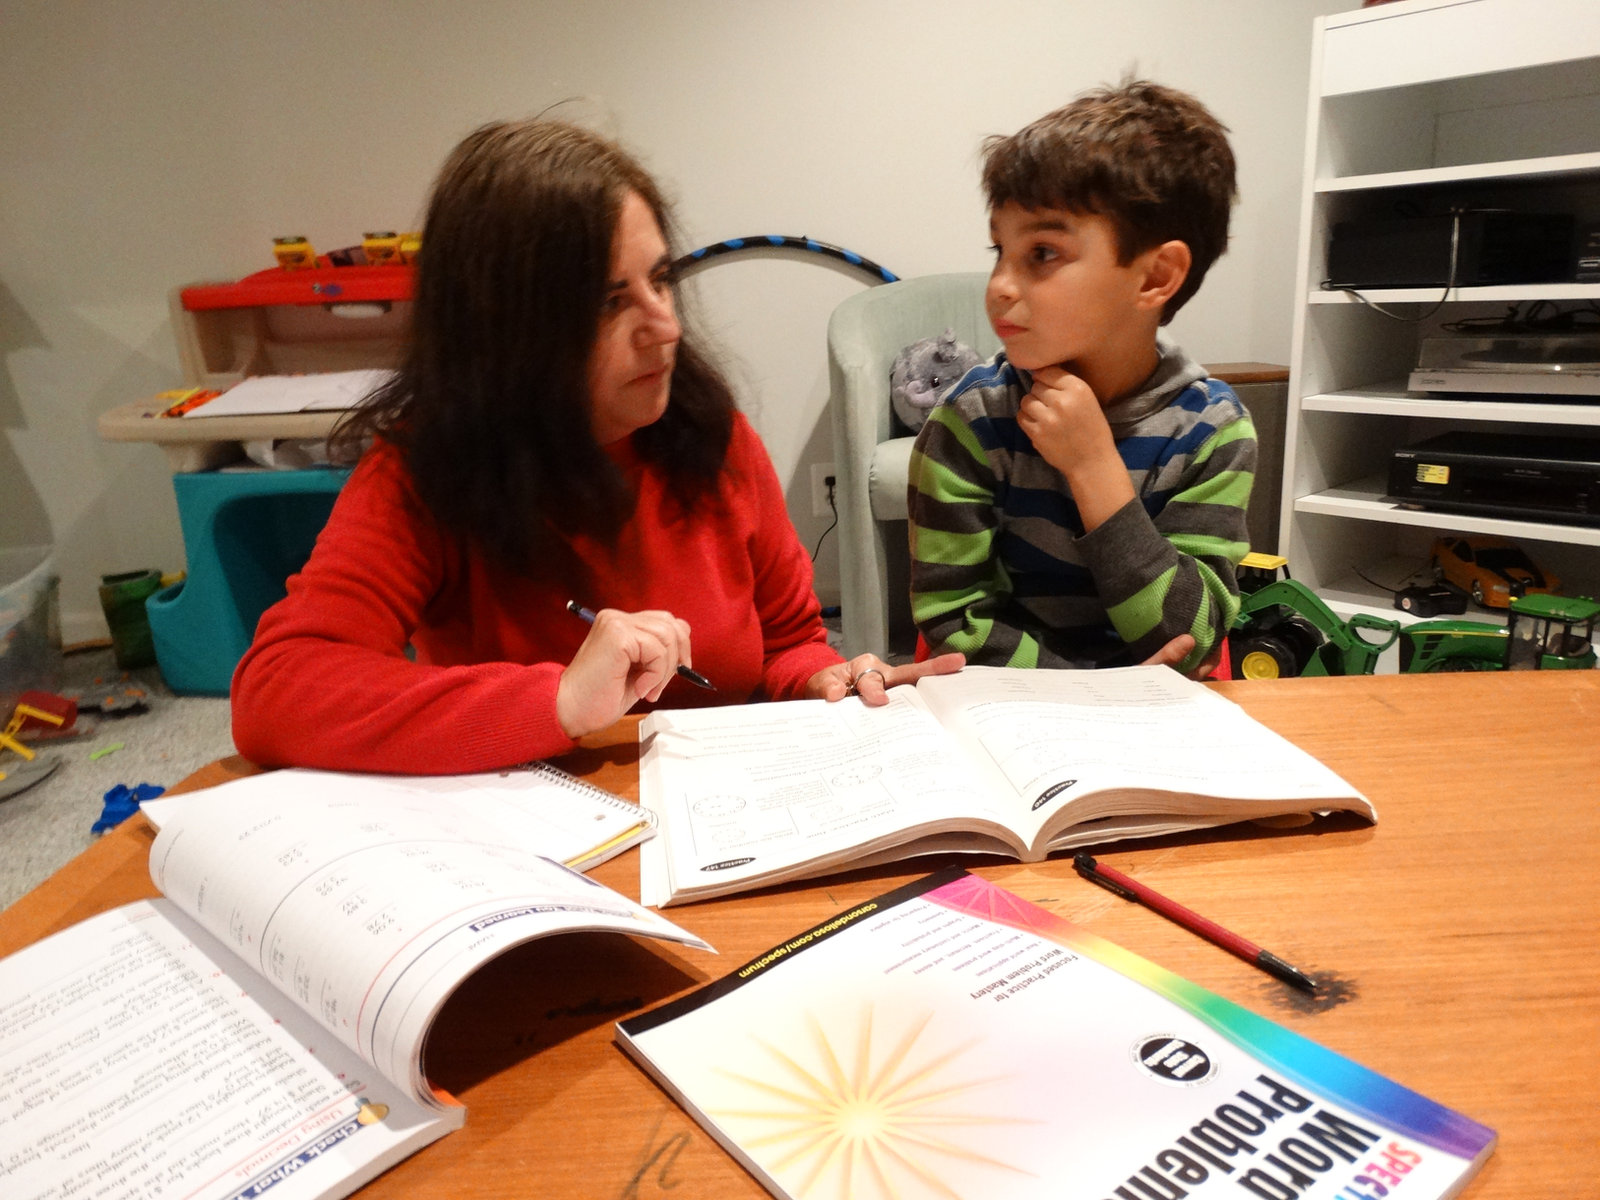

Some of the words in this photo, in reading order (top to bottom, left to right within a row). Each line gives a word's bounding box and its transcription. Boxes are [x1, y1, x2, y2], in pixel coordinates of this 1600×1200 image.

[1032, 795, 1047, 807] 140
[1044, 778, 1072, 798] Practice
[719, 856, 754, 868] Practice
[474, 908, 529, 929] Learned
[737, 902, 878, 979] carsondellosa.com/spectrum
[1038, 946, 1063, 964] Word
[1041, 952, 1078, 976] Focused
[1005, 957, 1042, 982] Problem
[968, 975, 1007, 1002] Mastery
[1006, 970, 1045, 996] Practice
[992, 990, 1009, 1004] for
[300, 1106, 344, 1138] Using
[304, 1120, 359, 1159] Check
[1106, 1074, 1313, 1200] Problem
[231, 1133, 303, 1182] Decimals
[1235, 1110, 1381, 1200] Word
[249, 1154, 306, 1194] What
[1332, 1141, 1423, 1200] SPECT
